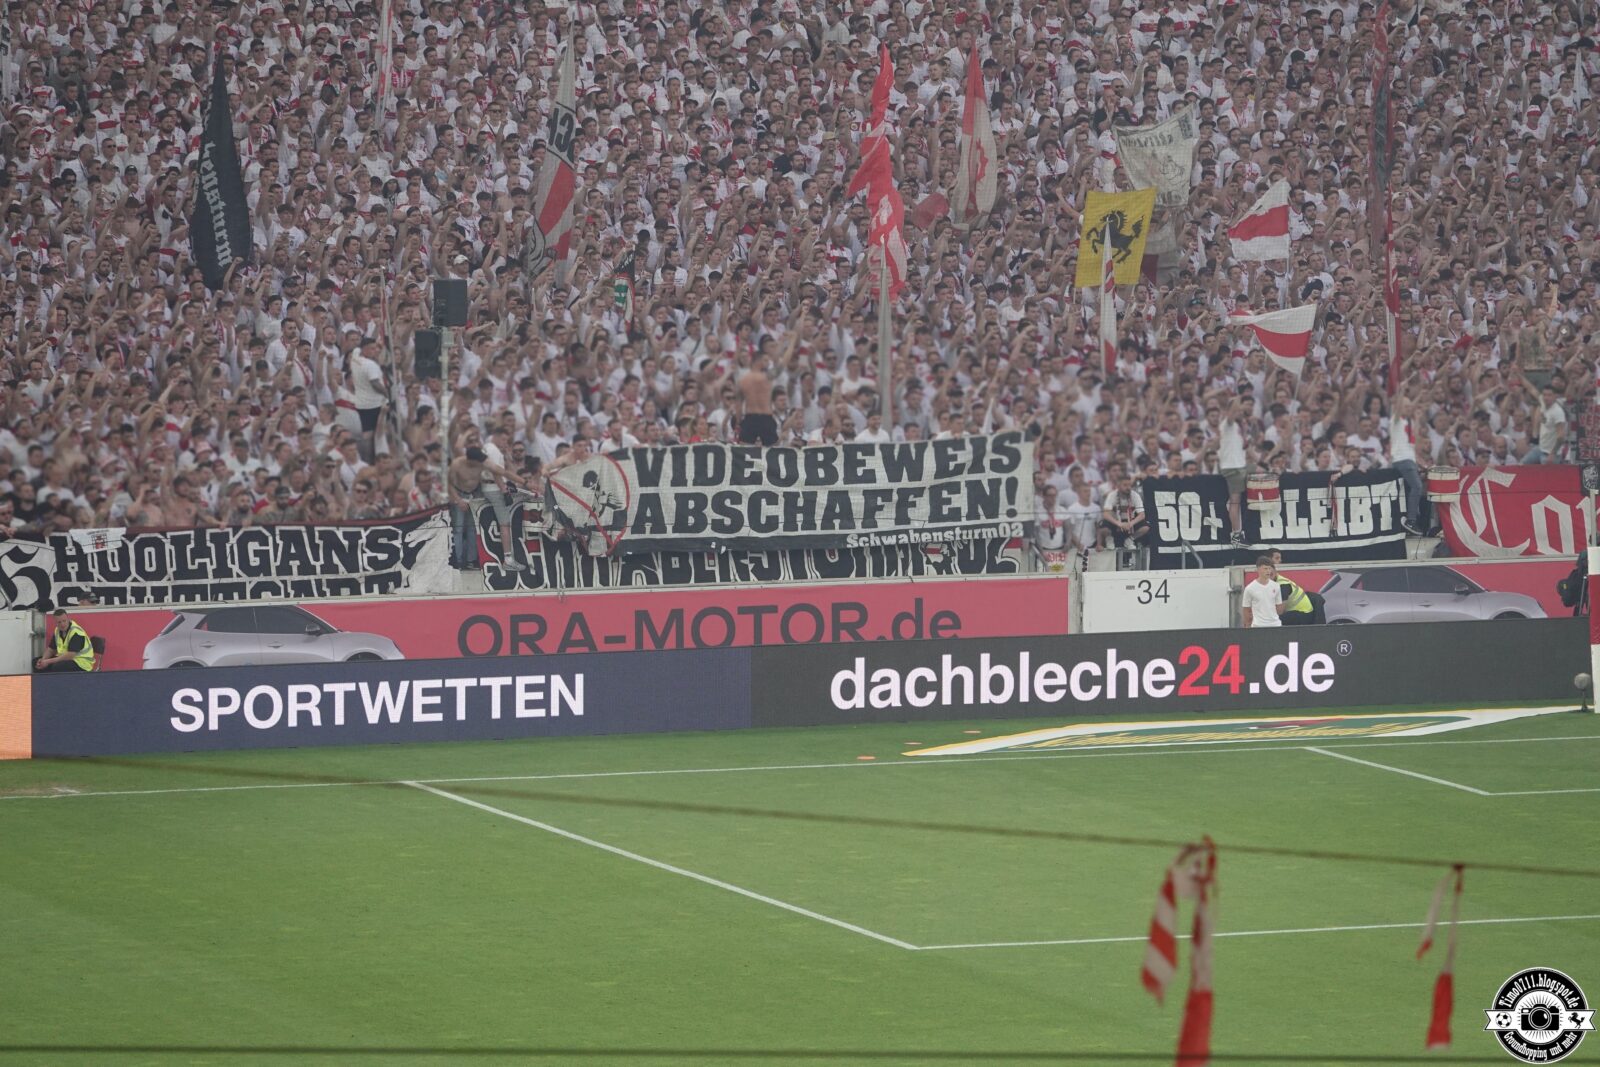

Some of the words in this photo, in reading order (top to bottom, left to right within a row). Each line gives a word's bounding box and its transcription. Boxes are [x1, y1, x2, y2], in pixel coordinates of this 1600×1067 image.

[632, 430, 1022, 488] VIDEOBEWEIS
[630, 476, 1019, 535] ABSCHAFFEN!
[50, 526, 402, 583] HOOLIGANS
[846, 522, 1024, 549] Schwabensturm02
[1137, 579, 1170, 604] 34
[457, 598, 962, 656] ORA-MOTOR.de
[170, 673, 584, 733] SPORTWETTEN
[830, 641, 1335, 710] dachbleche24.de
